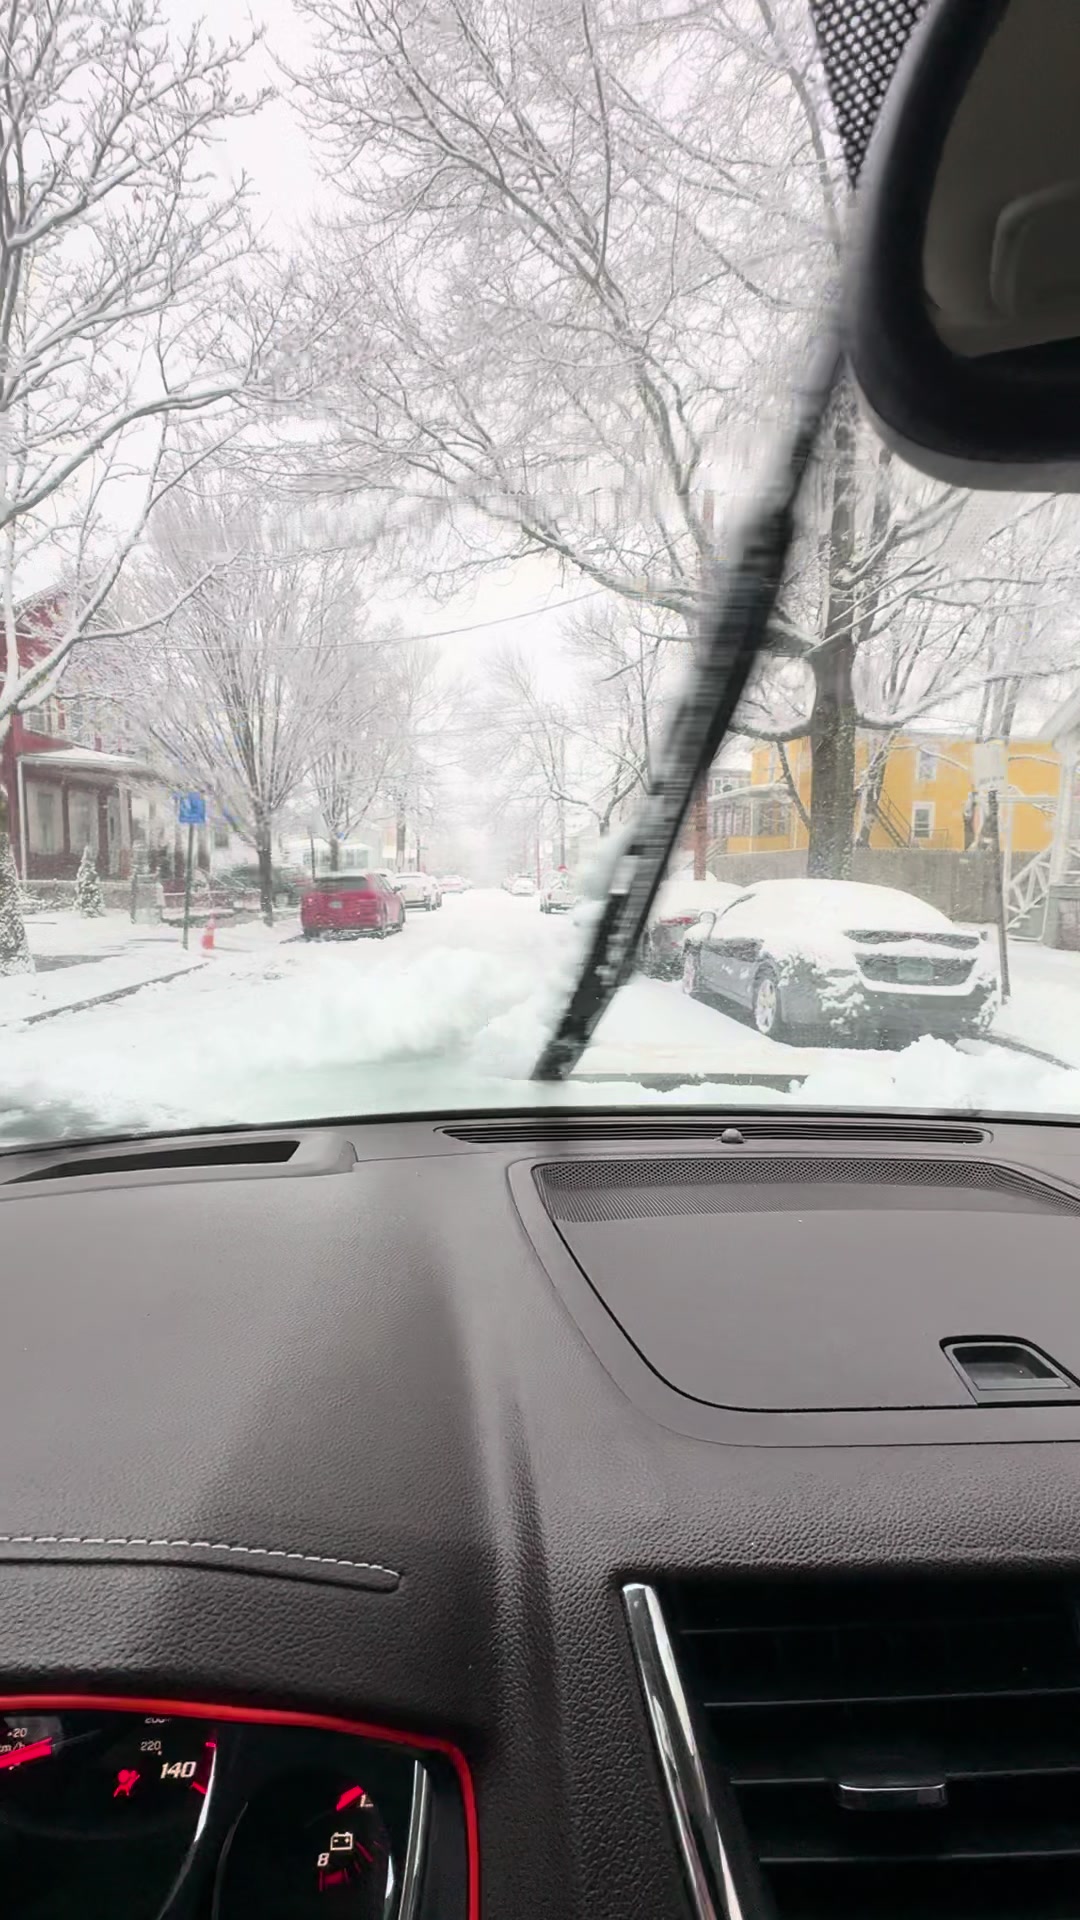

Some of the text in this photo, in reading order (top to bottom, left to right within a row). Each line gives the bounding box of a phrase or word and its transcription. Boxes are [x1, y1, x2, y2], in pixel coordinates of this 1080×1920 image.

[140, 1740, 162, 1751] 220
[160, 1760, 197, 1779] 140
[317, 1852, 330, 1867] 8
